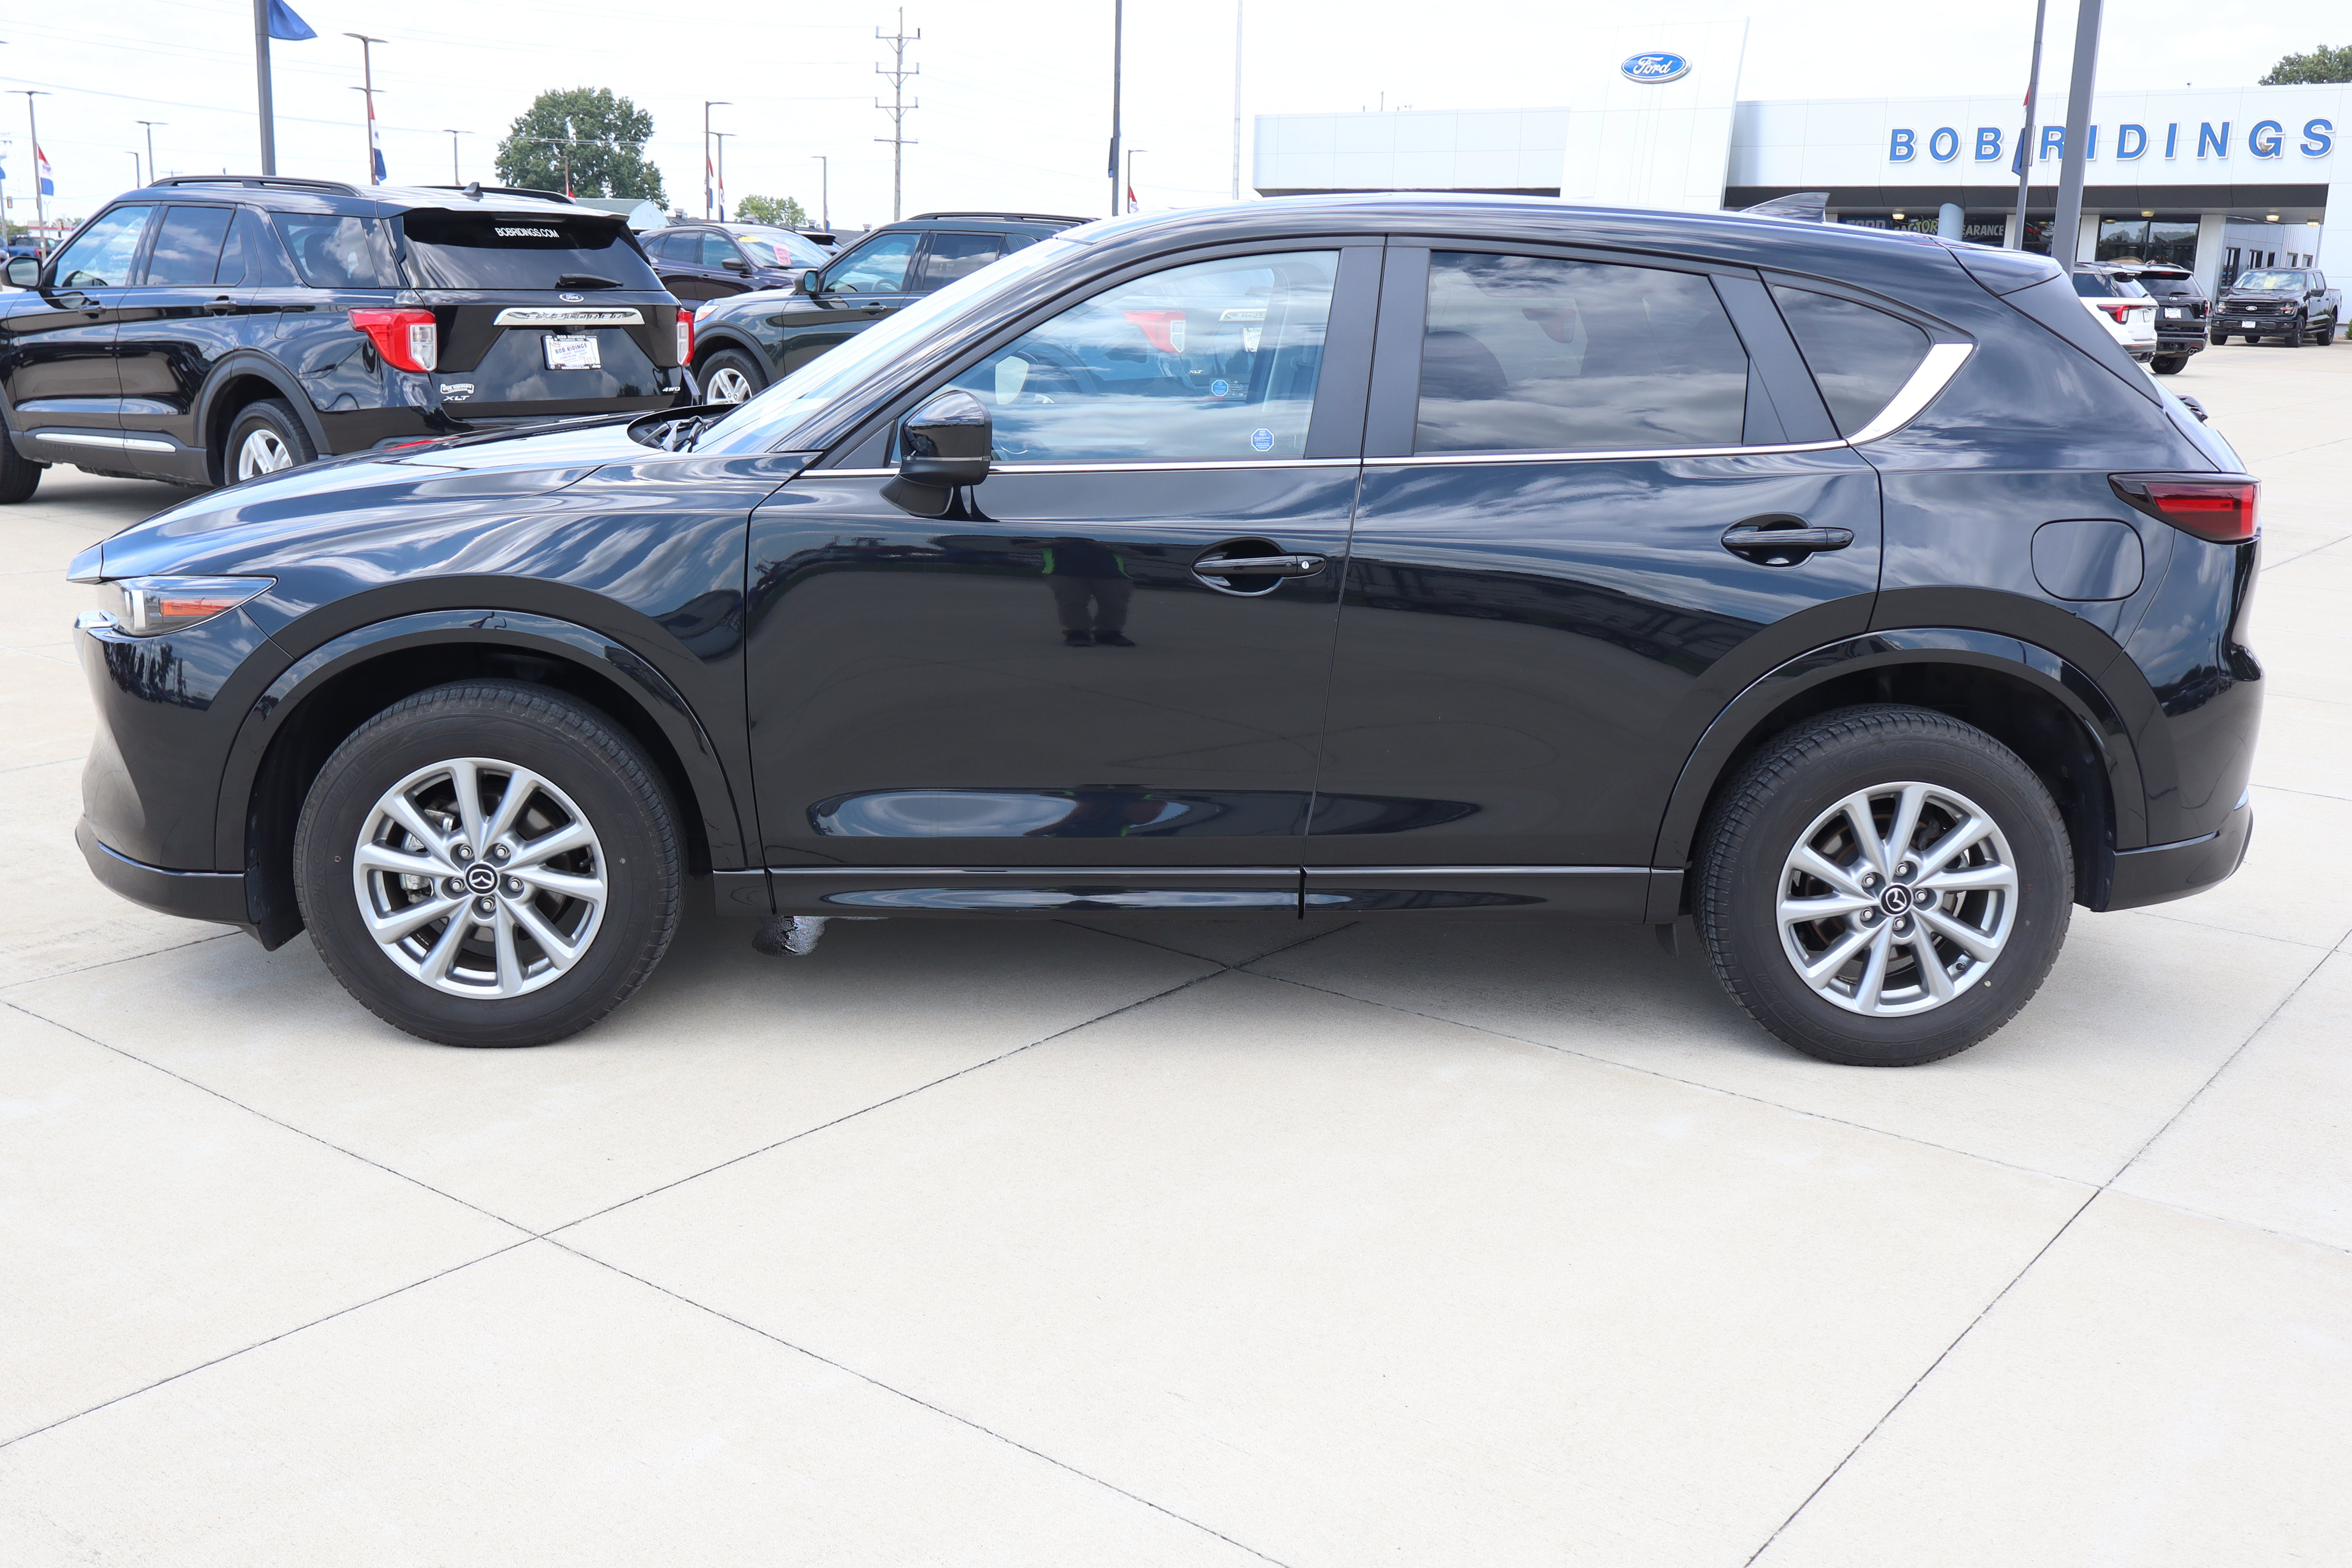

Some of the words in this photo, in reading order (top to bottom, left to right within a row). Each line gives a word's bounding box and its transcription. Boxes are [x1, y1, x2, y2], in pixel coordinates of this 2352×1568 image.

[1633, 56, 1673, 74] Ford
[1889, 126, 2004, 163] BOB
[2038, 117, 2335, 162] RIDINGS
[494, 227, 560, 238] BOBRIDINGS.COM
[567, 343, 587, 352] RIDINGS
[1826, 740, 2004, 784] YOKOHAMA
[309, 763, 363, 936] YOKOHAMA
